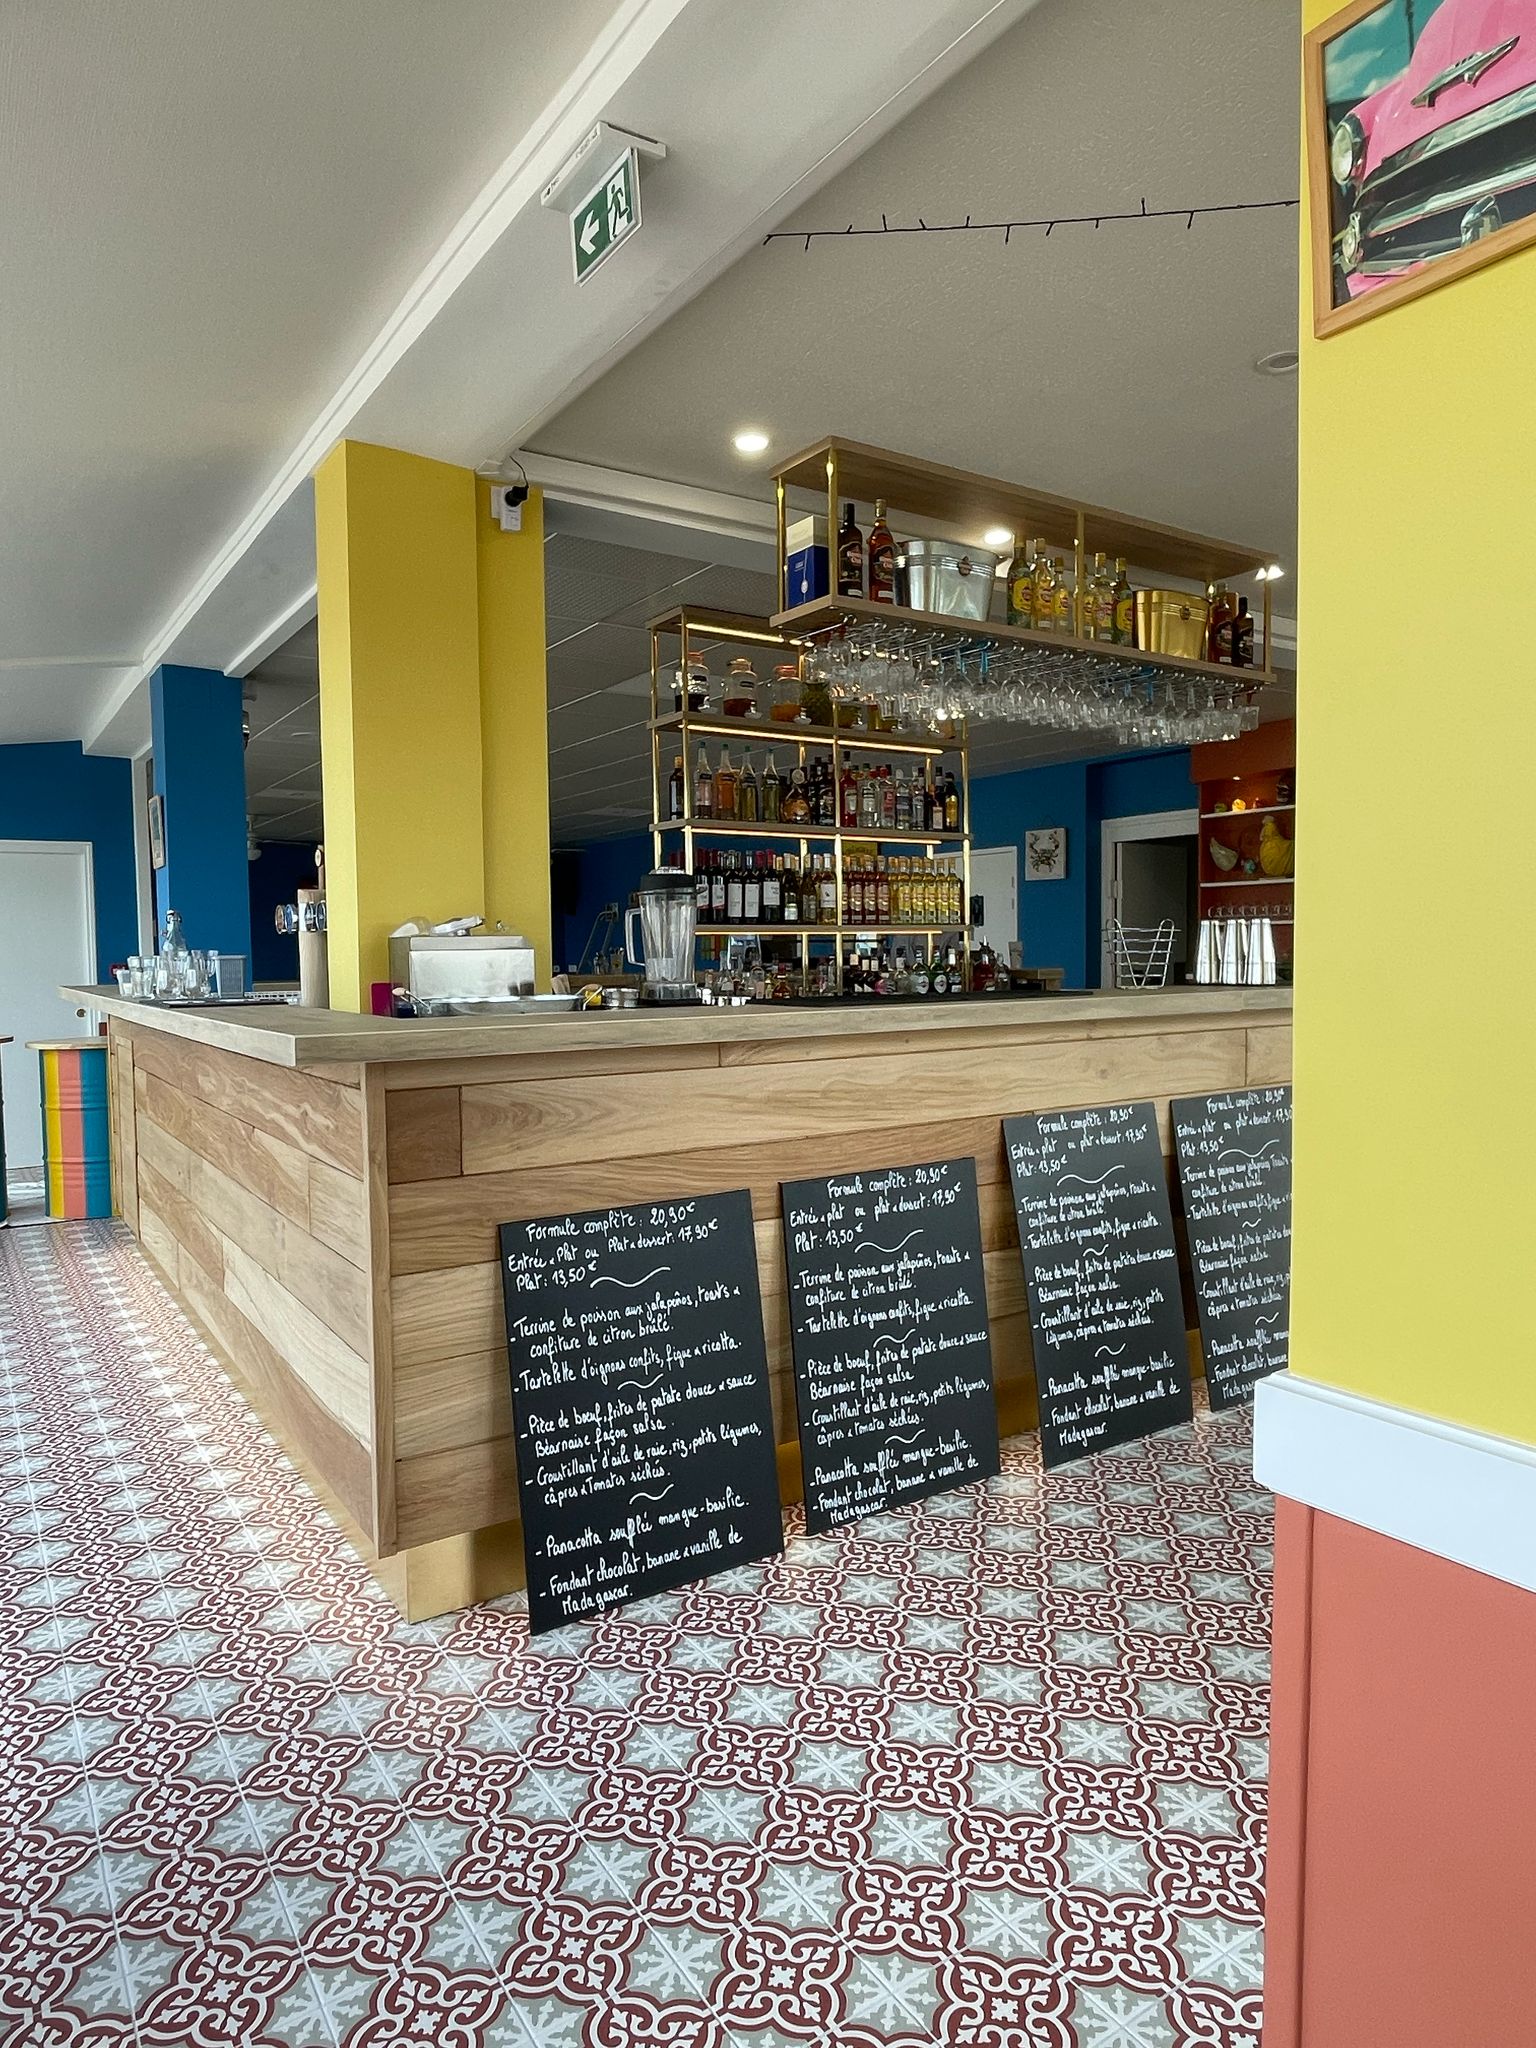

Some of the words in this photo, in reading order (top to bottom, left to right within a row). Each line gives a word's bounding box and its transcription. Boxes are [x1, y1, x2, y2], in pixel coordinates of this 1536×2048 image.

[525, 1218, 580, 1242] Formule
[650, 1202, 695, 1230] 20,90€
[508, 1248, 547, 1272] Entrée
[556, 1242, 578, 1262] Plat
[585, 1248, 600, 1259] ou
[608, 1236, 629, 1253] Plat
[678, 1218, 718, 1243] 17,90€
[551, 1257, 597, 1288] 13,50€
[513, 1316, 556, 1340] Terrine
[562, 1308, 576, 1328] de
[580, 1306, 621, 1333] poisson
[625, 1304, 644, 1317] aux
[697, 1281, 730, 1302] toasts
[530, 1334, 581, 1364] confiture
[587, 1329, 598, 1346] de
[602, 1325, 636, 1344] citron
[519, 1360, 576, 1392] Tartelette
[666, 1344, 692, 1371] figue
[558, 1409, 570, 1428] de
[636, 1394, 648, 1412] de
[634, 1444, 645, 1461] de
[728, 1524, 743, 1544] de
